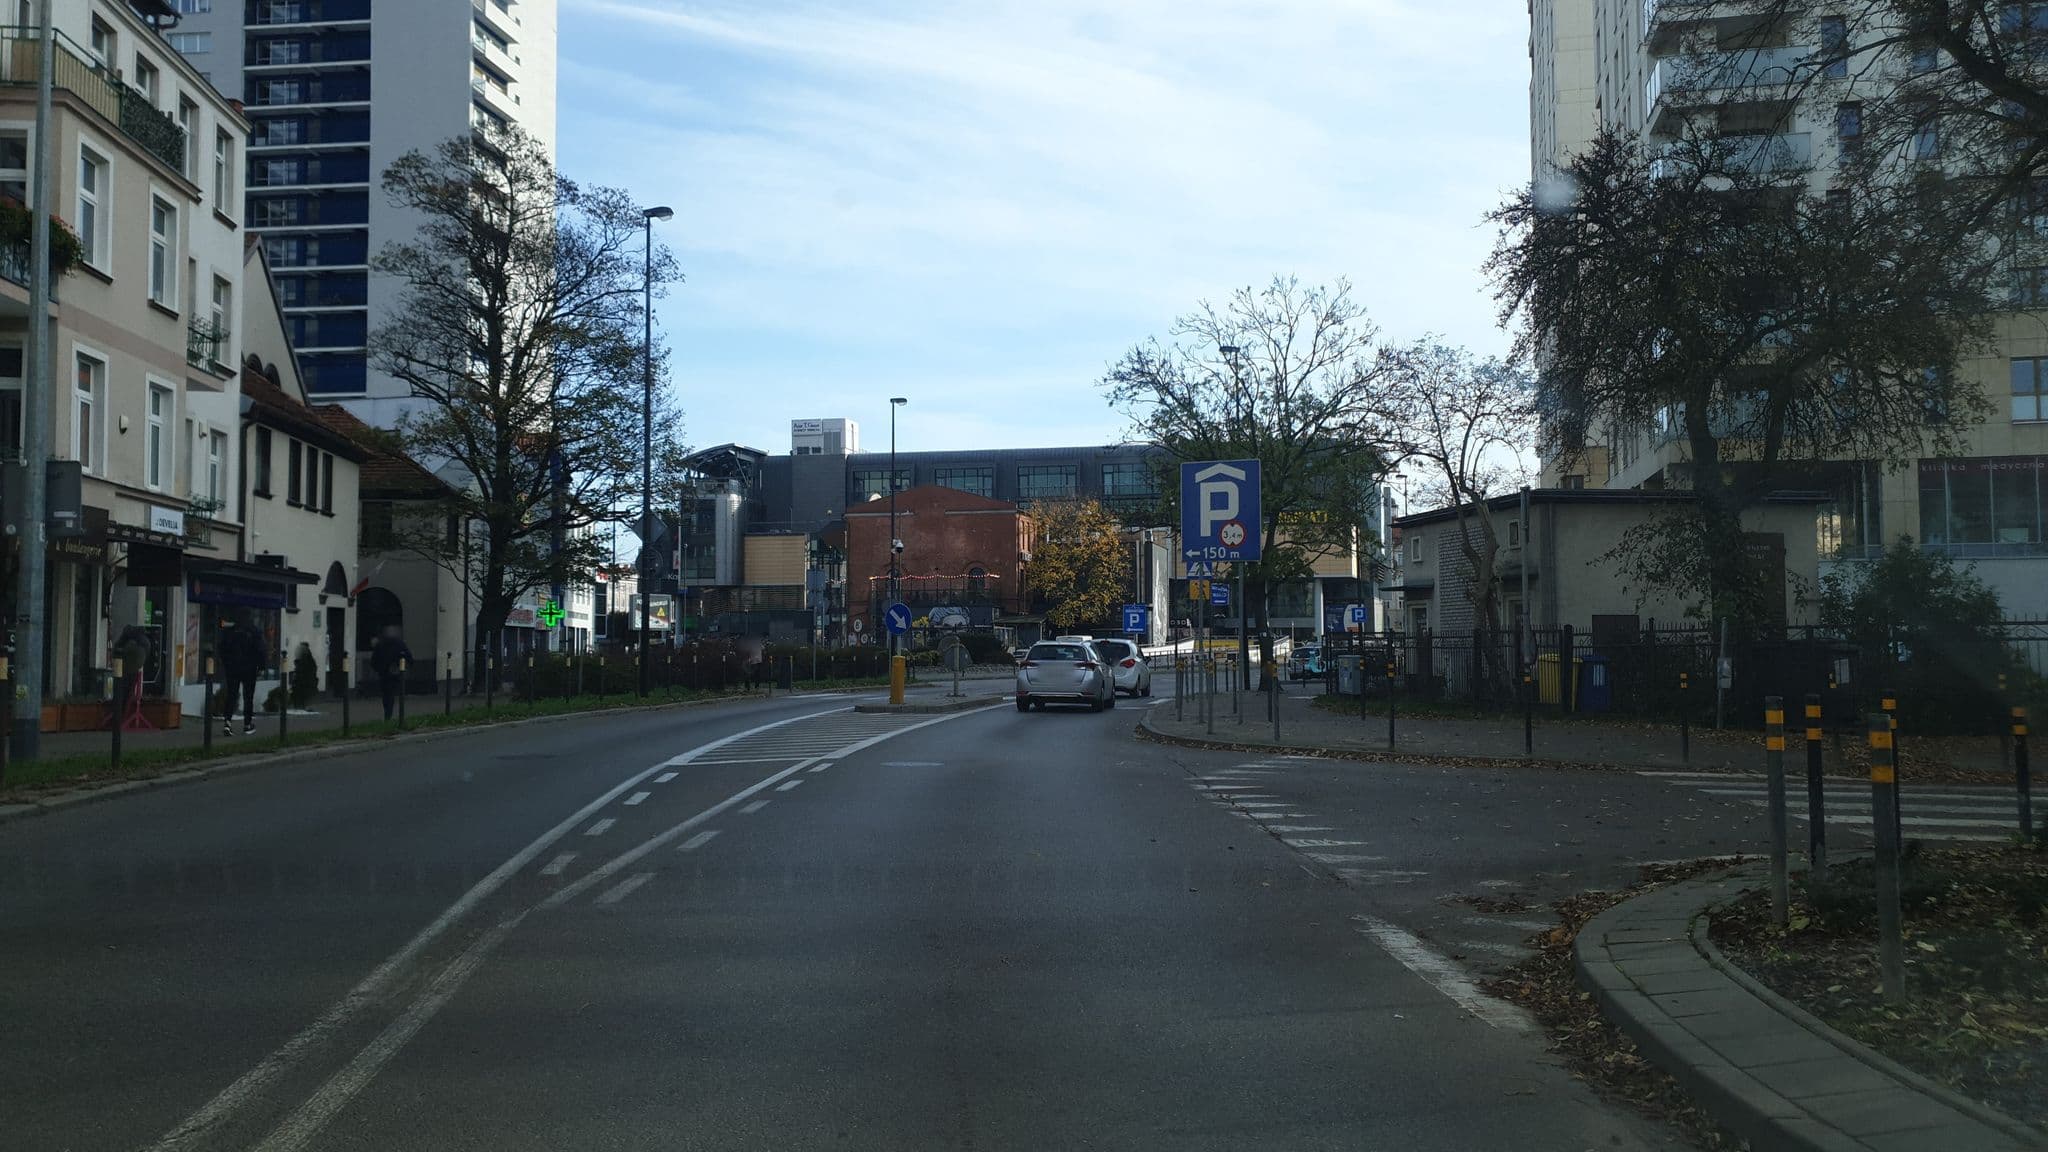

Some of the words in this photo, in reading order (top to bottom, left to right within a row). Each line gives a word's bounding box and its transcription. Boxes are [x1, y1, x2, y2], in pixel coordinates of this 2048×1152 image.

[1200, 481, 1239, 537] P
[1203, 547, 1226, 559] 150
[1129, 613, 1140, 627] P
[1354, 609, 1364, 621] P
